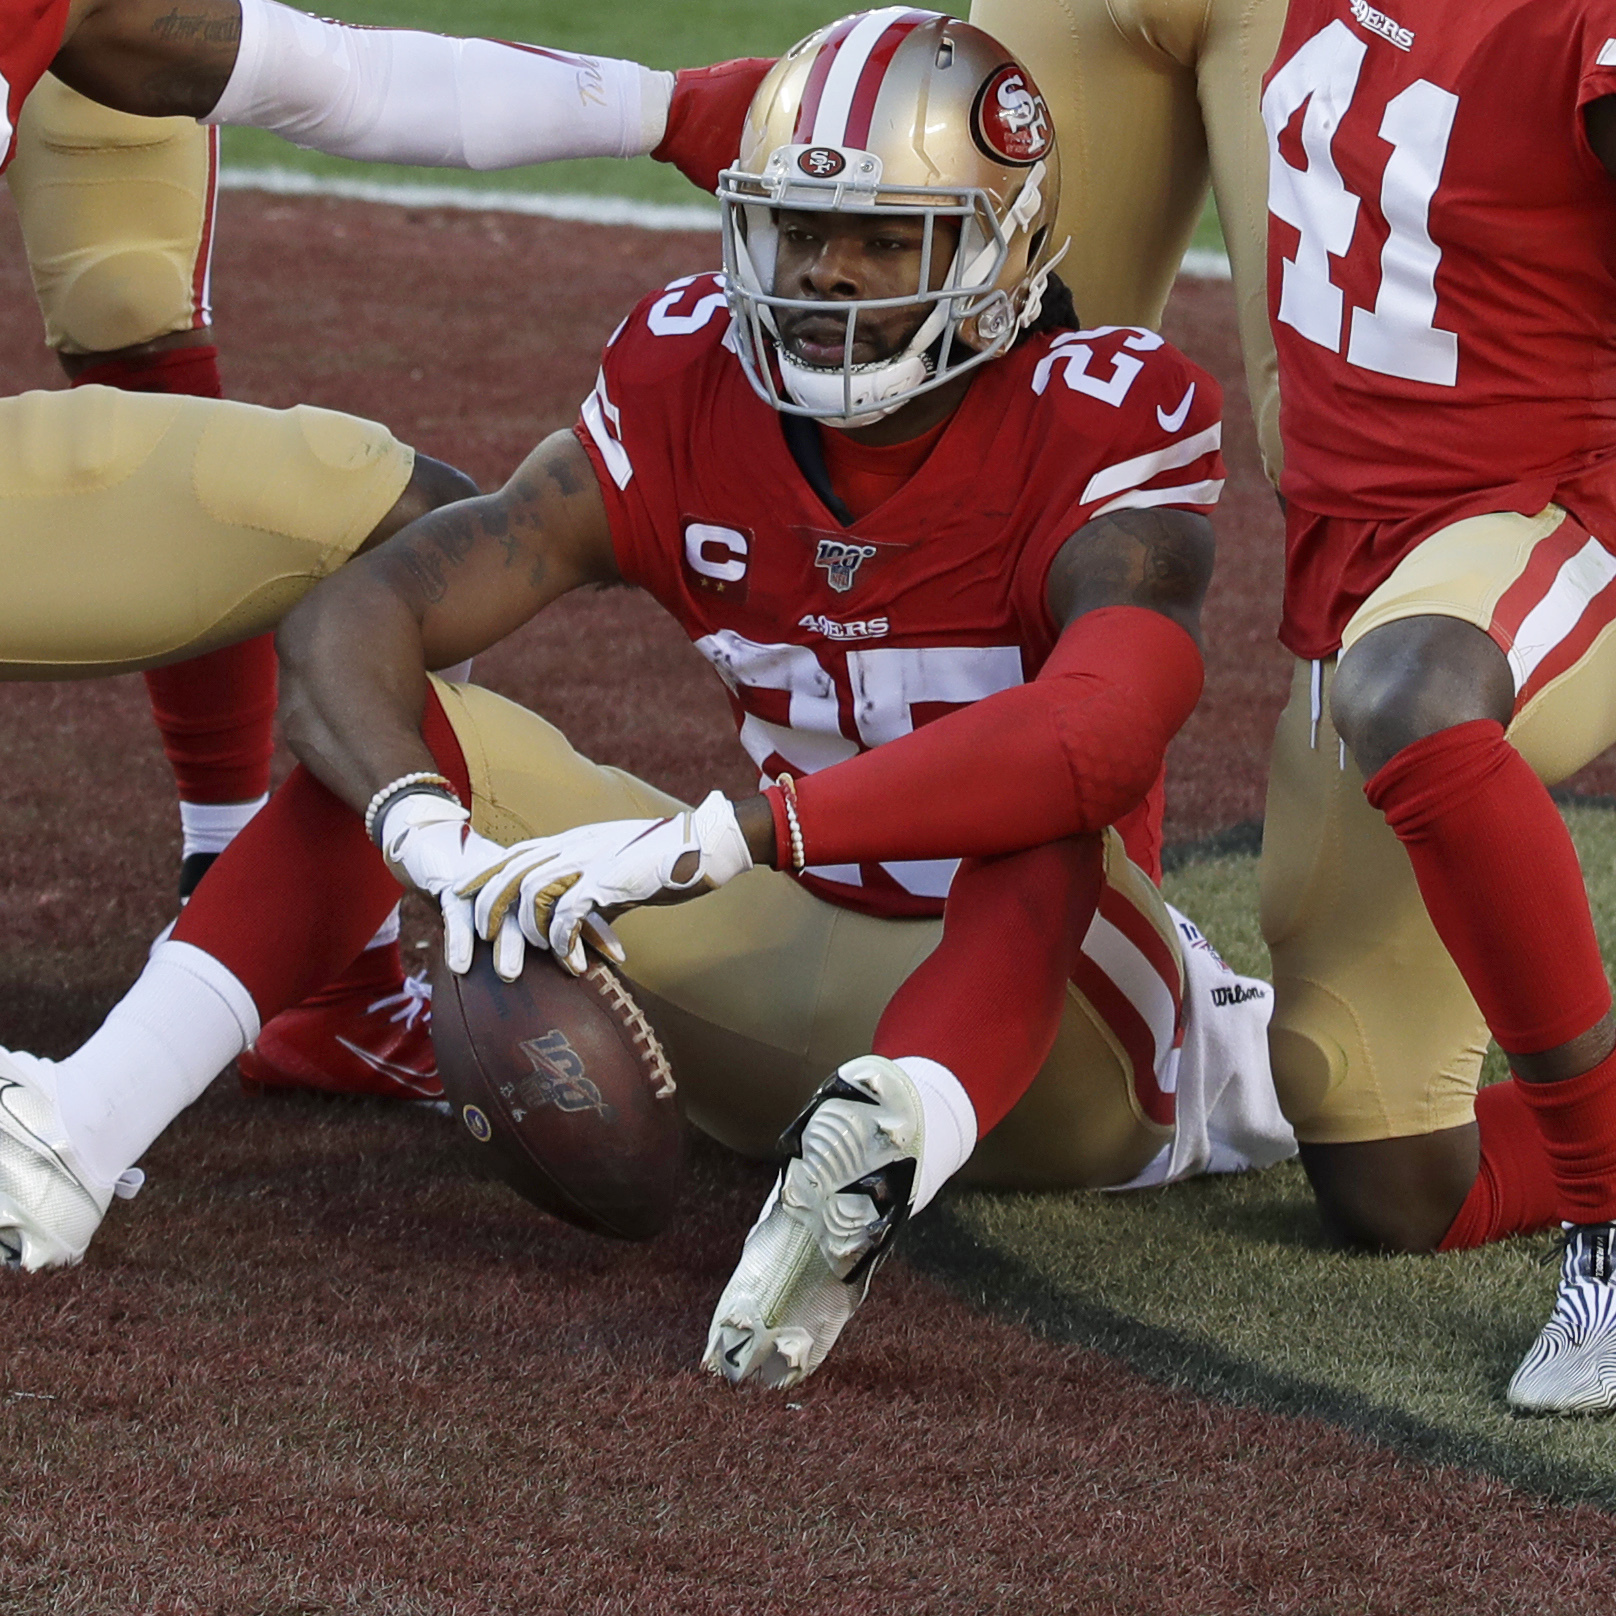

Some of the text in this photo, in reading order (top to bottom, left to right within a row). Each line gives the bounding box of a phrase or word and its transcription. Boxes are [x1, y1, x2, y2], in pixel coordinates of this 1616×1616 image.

[997, 74, 1048, 155] SF
[809, 150, 837, 174] SF
[1261, 18, 1460, 387] 41
[685, 523, 747, 582] C
[797, 613, 890, 640] 49ERS
[1210, 984, 1261, 1008] Wilson
